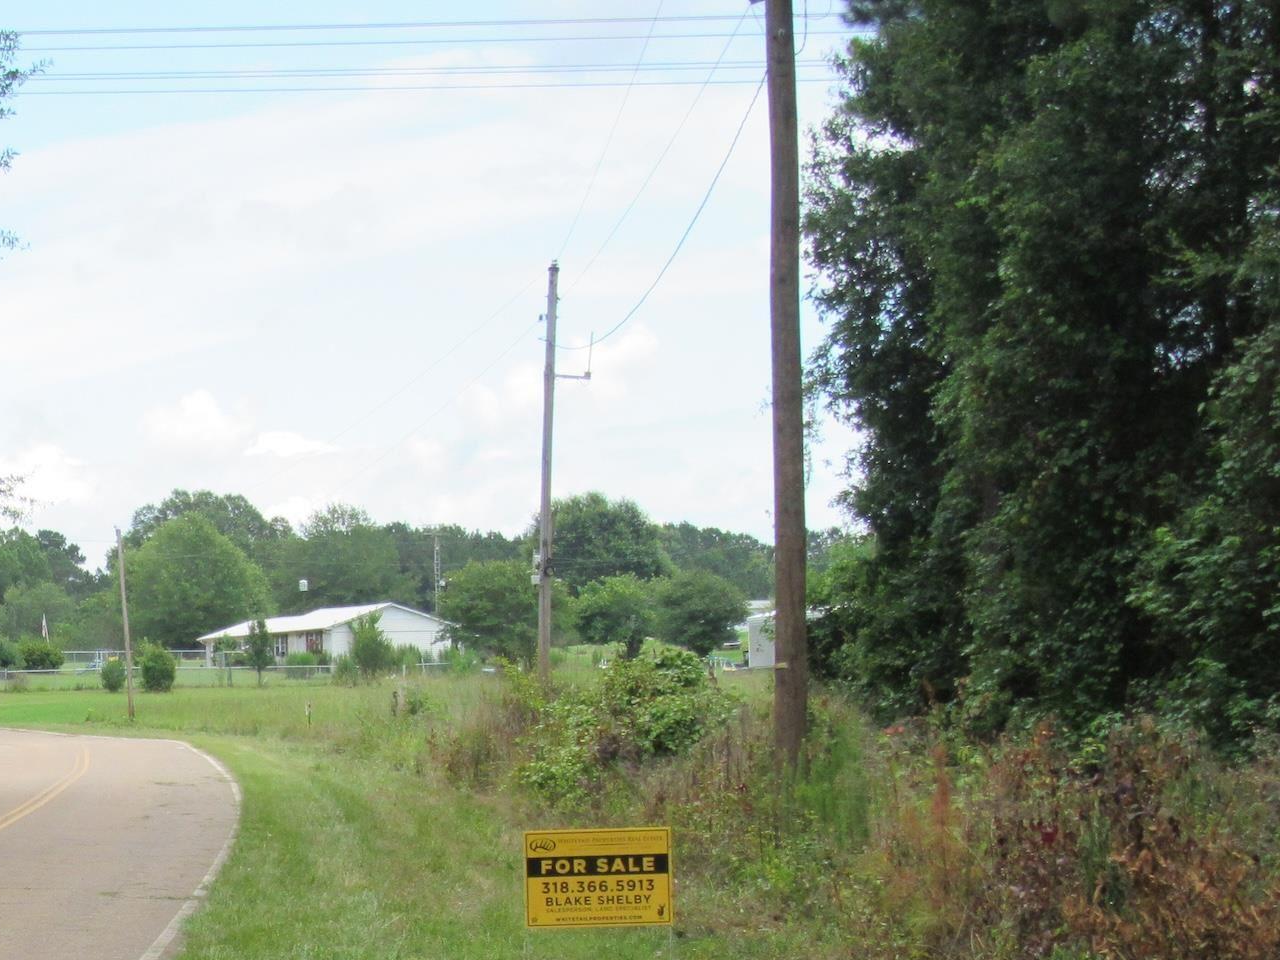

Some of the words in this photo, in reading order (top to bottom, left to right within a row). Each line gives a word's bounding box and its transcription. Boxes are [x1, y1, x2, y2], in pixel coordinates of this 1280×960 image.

[540, 858, 587, 875] FOR
[596, 857, 656, 873] SALE
[541, 879, 655, 894] 318.366.5913
[545, 896, 592, 907] BLAKE
[597, 894, 652, 905] SHELBY
